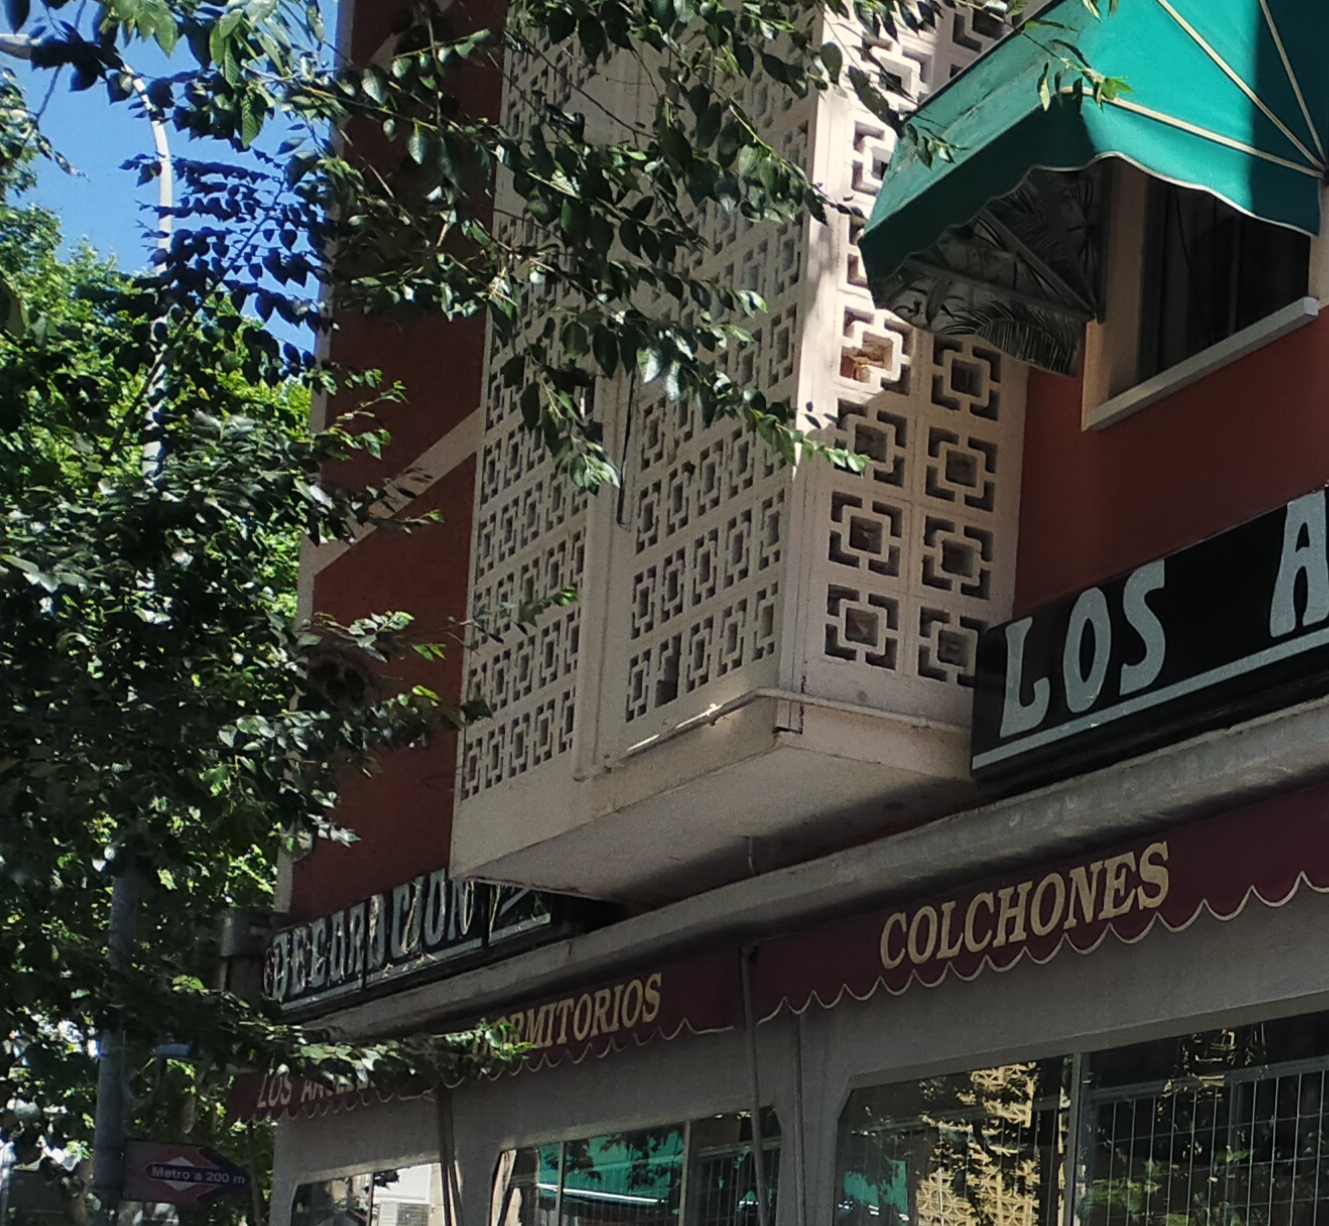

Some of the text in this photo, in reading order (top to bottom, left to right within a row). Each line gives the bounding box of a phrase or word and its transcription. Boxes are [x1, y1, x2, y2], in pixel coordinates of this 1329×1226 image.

[1000, 559, 1167, 738] LOS
[880, 841, 1170, 969] COLCHONES
[152, 1166, 245, 1184] Metro a 200 m
